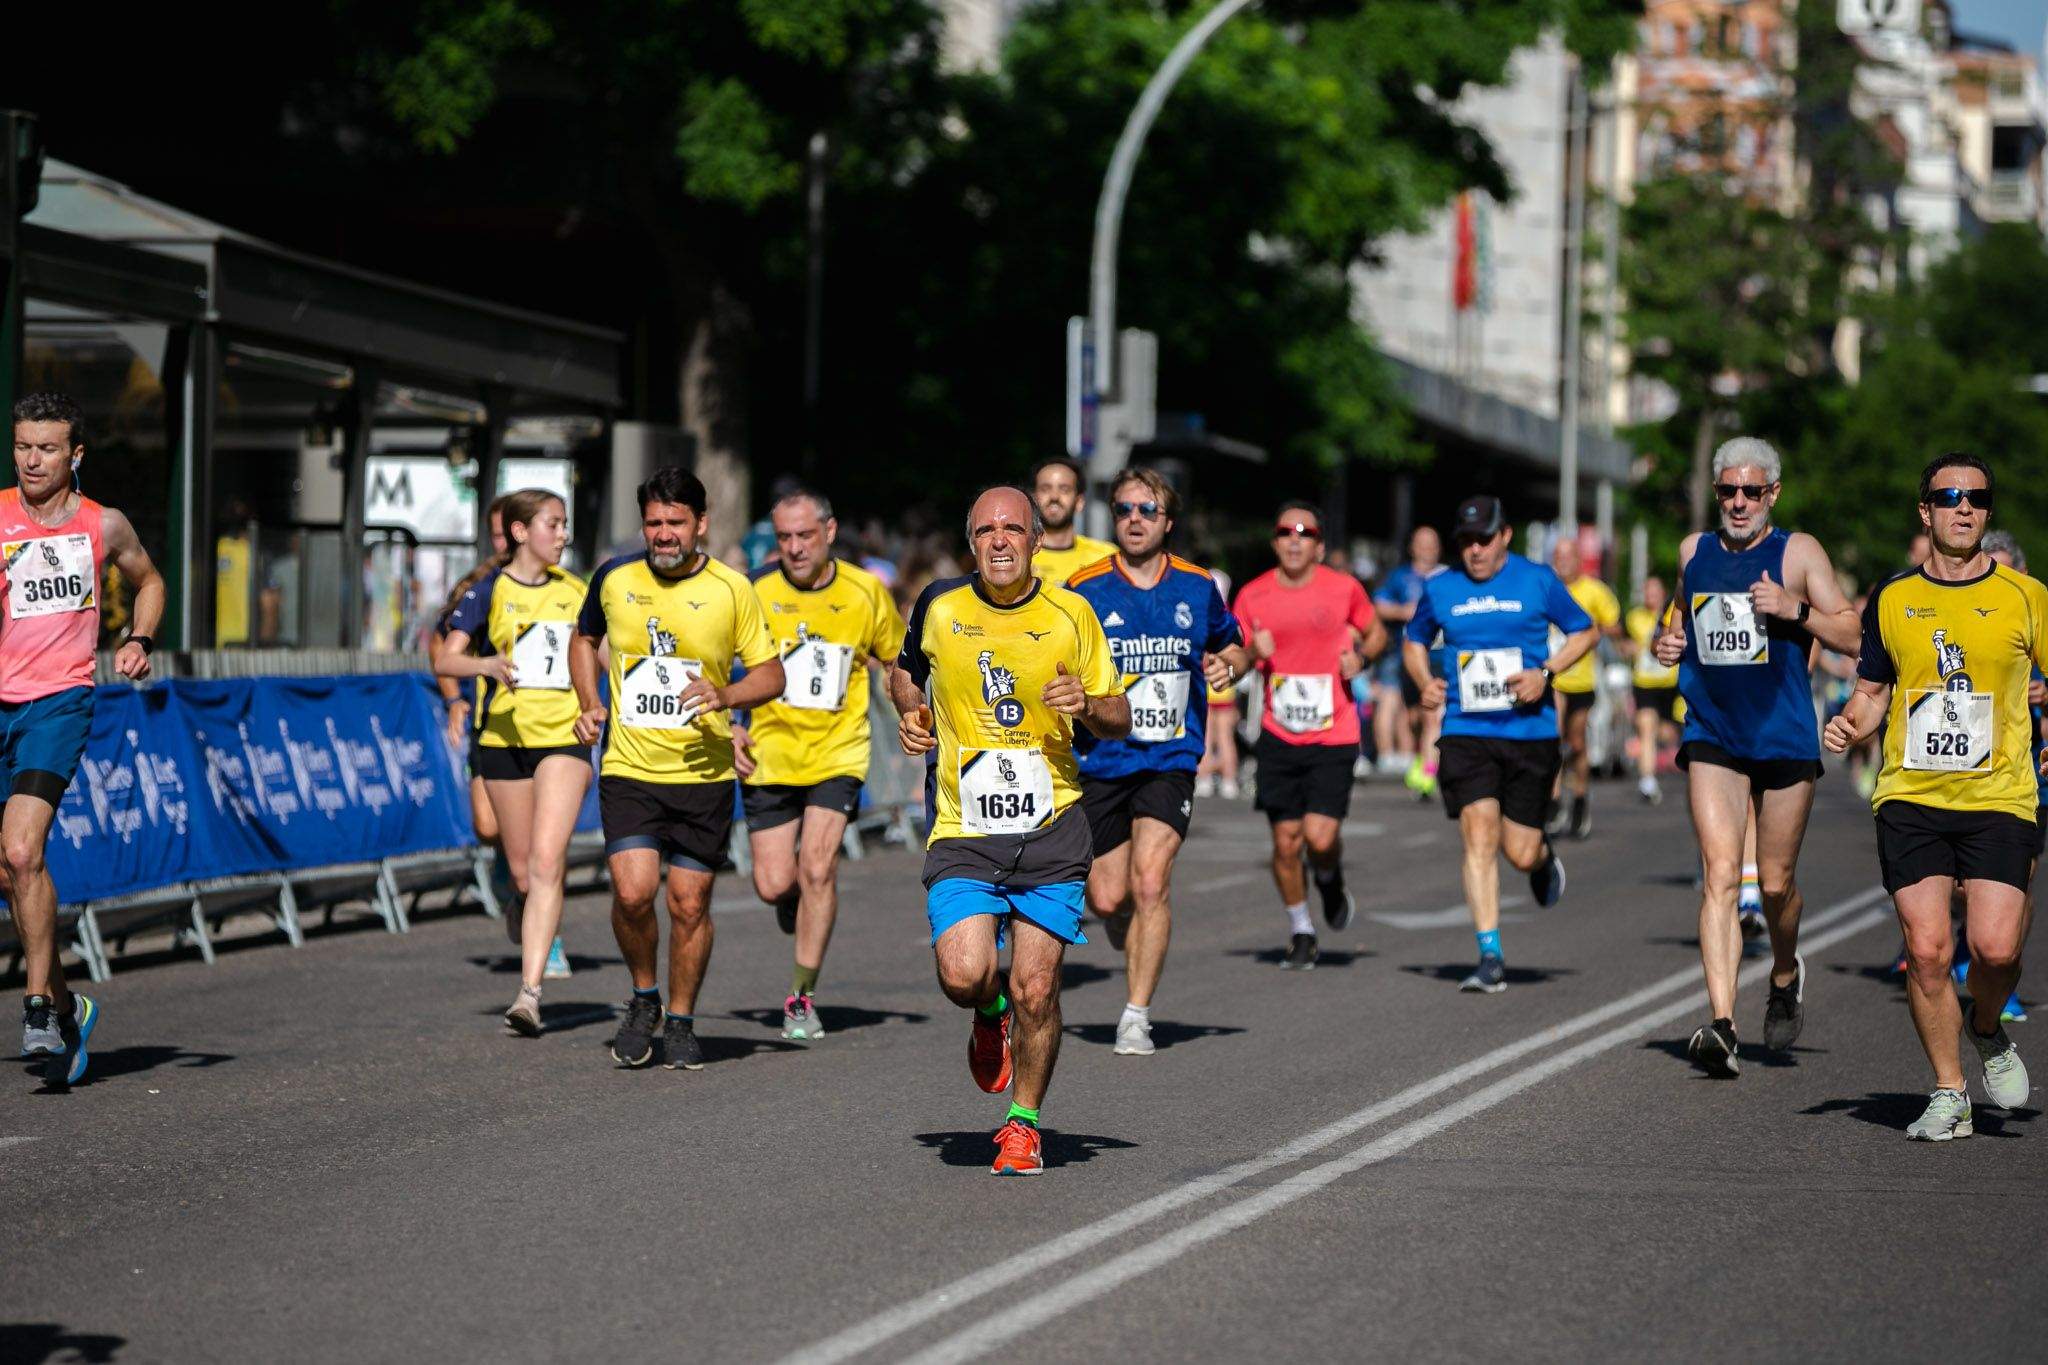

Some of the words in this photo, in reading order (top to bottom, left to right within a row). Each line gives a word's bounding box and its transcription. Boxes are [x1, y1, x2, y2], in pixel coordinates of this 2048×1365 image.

[372, 468, 414, 506] M
[24, 574, 82, 602] 3606
[1108, 634, 1191, 657] Emirates
[1707, 630, 1751, 651] 1299
[544, 655, 555, 675] 7
[1122, 656, 1143, 673] FLY
[1143, 654, 1180, 672] BETTER
[810, 677, 821, 695] 6
[1953, 679, 1968, 692] 13
[1000, 704, 1018, 720] 13
[1133, 708, 1177, 728] 3534
[1004, 729, 1030, 737] Carrera
[1005, 737, 1029, 746] Liberty
[1926, 732, 1969, 756] 528
[976, 792, 1035, 819] 1634
